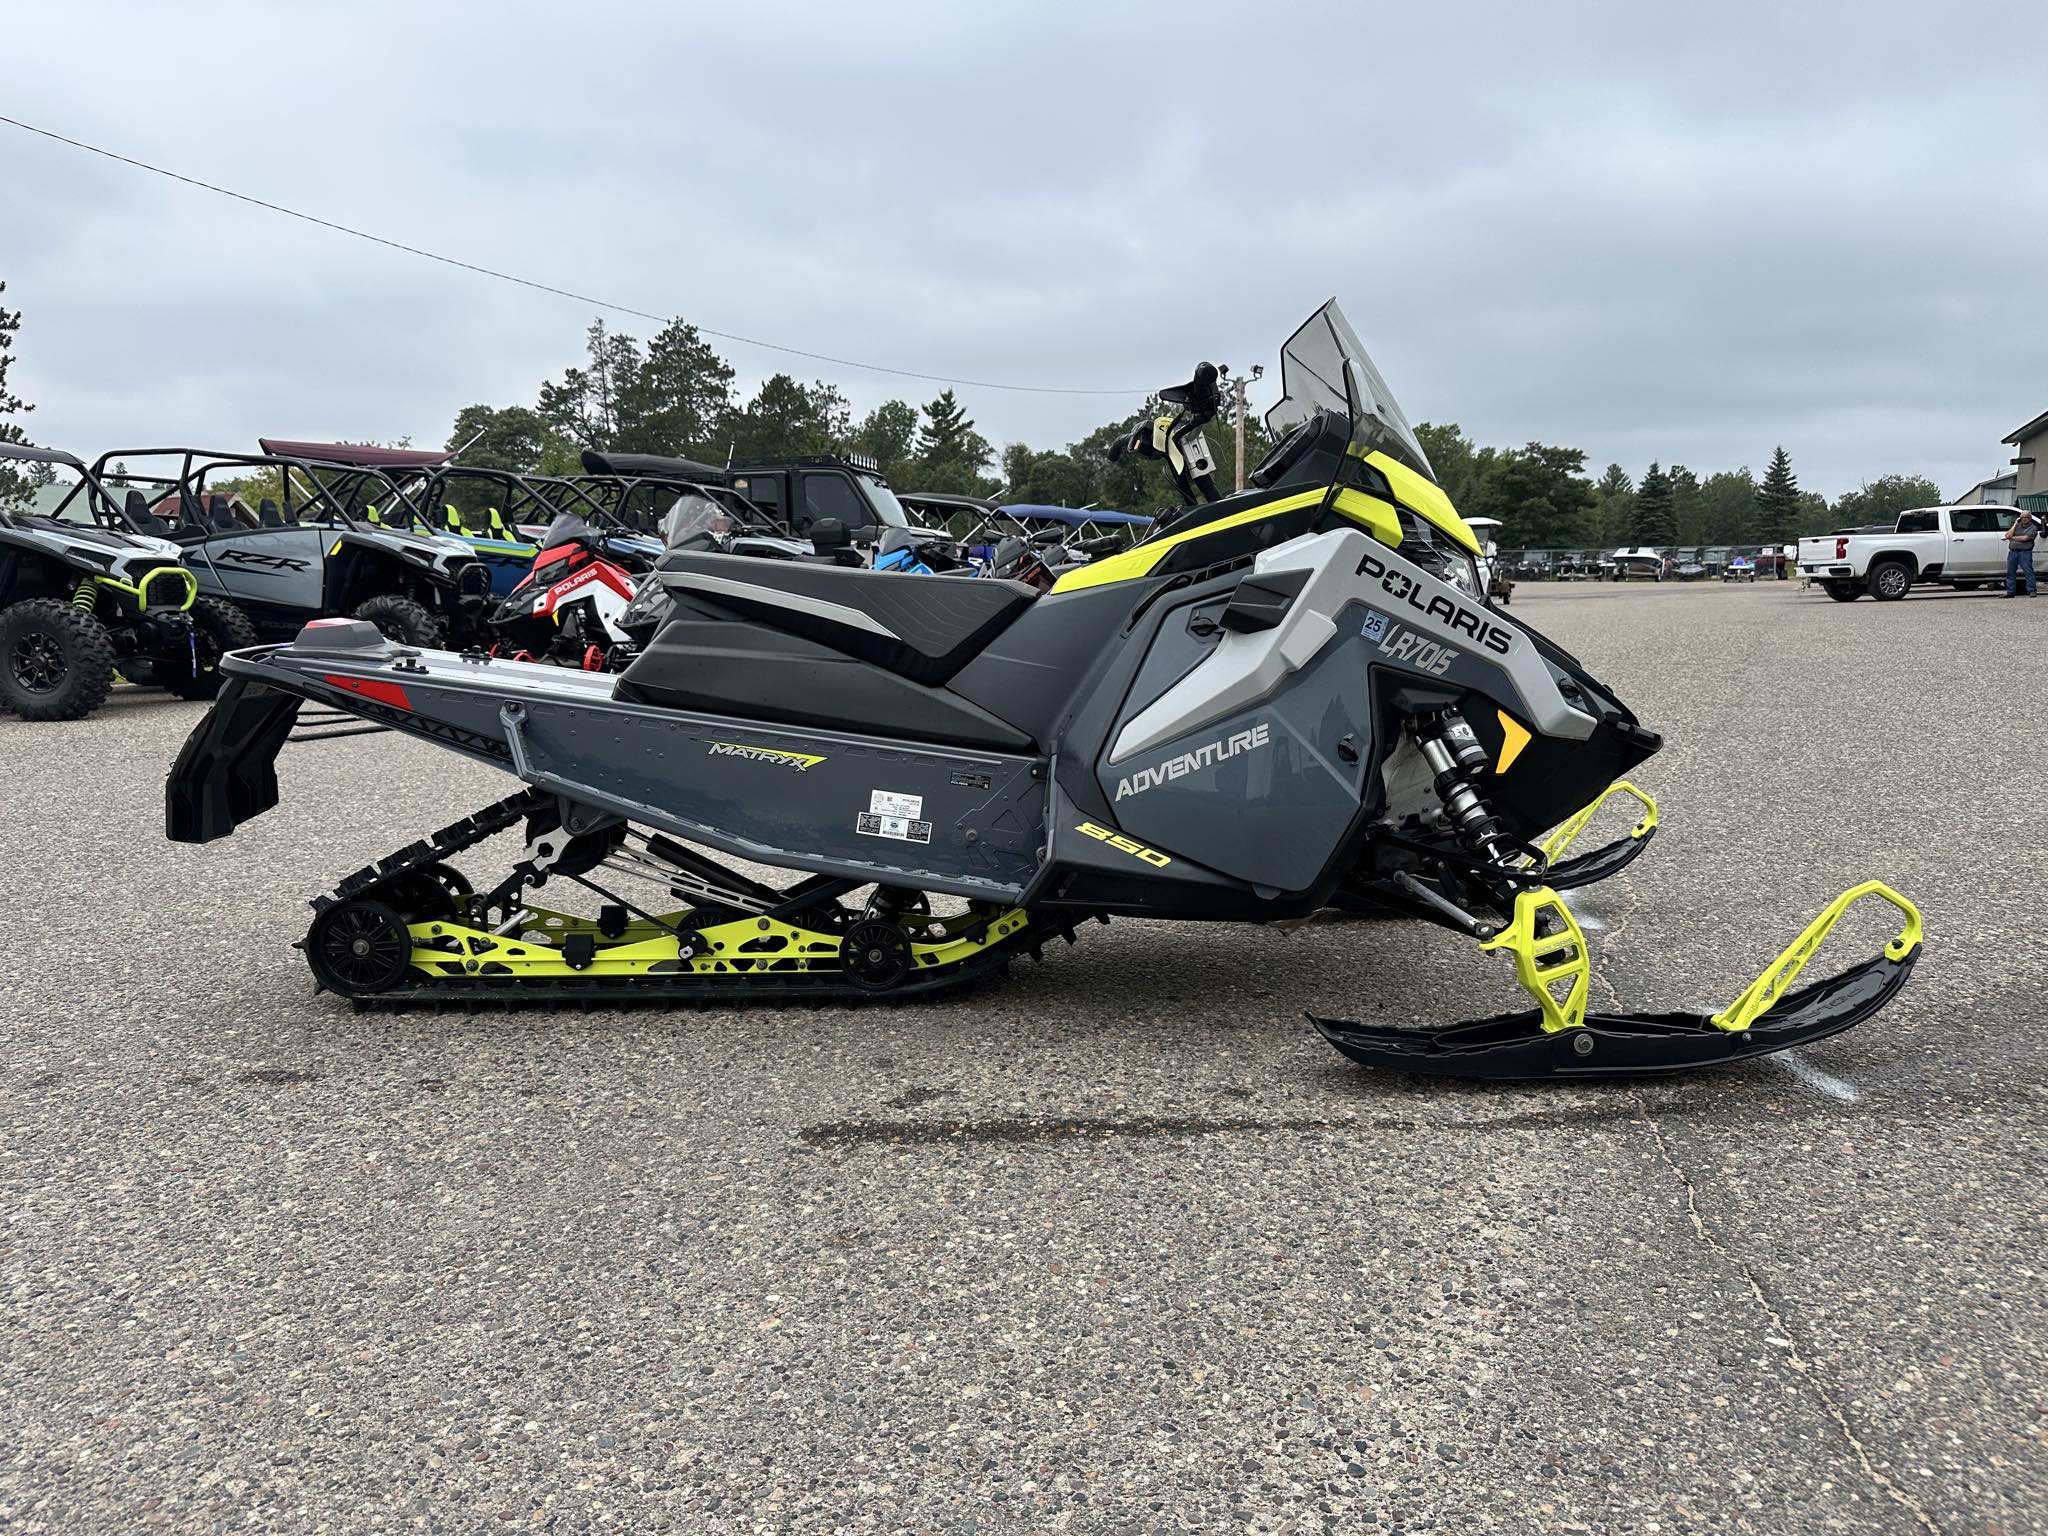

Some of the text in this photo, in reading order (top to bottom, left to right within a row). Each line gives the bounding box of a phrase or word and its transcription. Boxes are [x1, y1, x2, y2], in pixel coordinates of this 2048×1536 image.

[216, 549, 311, 573] RZR
[554, 567, 598, 595] POLARIS
[1355, 554, 1513, 655] POLARIS
[1365, 616, 1382, 632] 25
[1377, 623, 1461, 676] LR7015
[708, 742, 807, 772] MATRYX
[1115, 723, 1270, 801] ADVENTURE
[1074, 822, 1172, 868] 850
